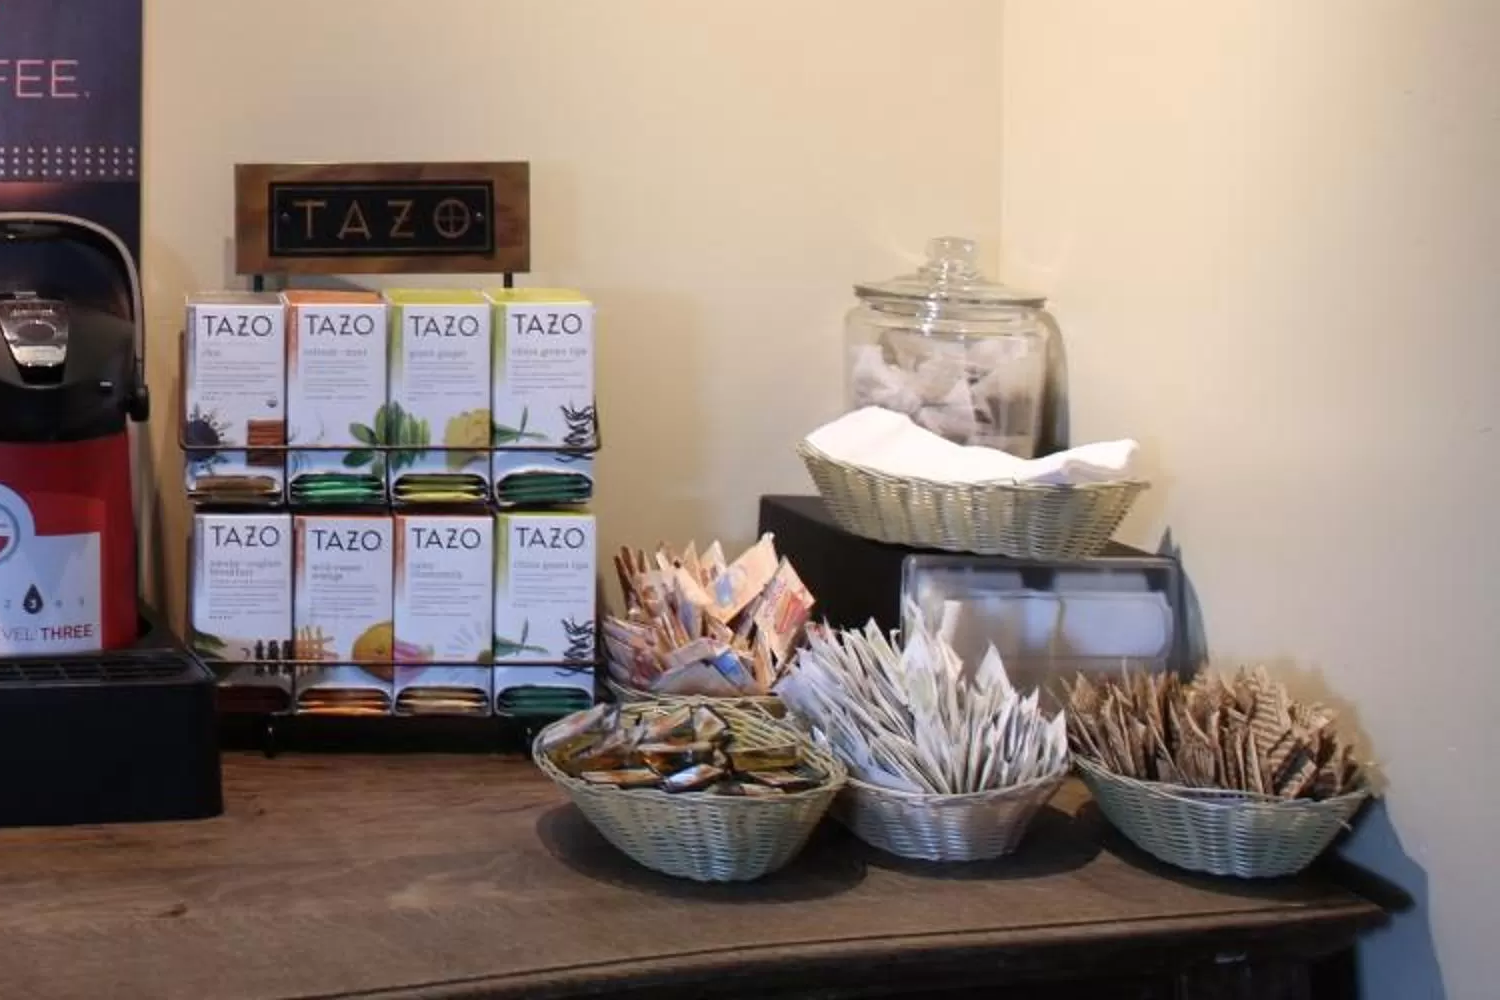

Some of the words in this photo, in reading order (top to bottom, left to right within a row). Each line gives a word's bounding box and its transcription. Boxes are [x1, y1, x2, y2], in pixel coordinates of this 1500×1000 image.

[293, 199, 471, 240] TAZO
[202, 315, 274, 338] TAZO
[303, 313, 376, 336] TAZO
[408, 314, 480, 337] TAZO
[511, 313, 583, 336] TAZO
[209, 524, 281, 548] TAZO
[311, 529, 383, 551] TAZO
[411, 526, 482, 549] TAZO
[515, 526, 586, 549] TAZO
[40, 623, 94, 641] THREE
